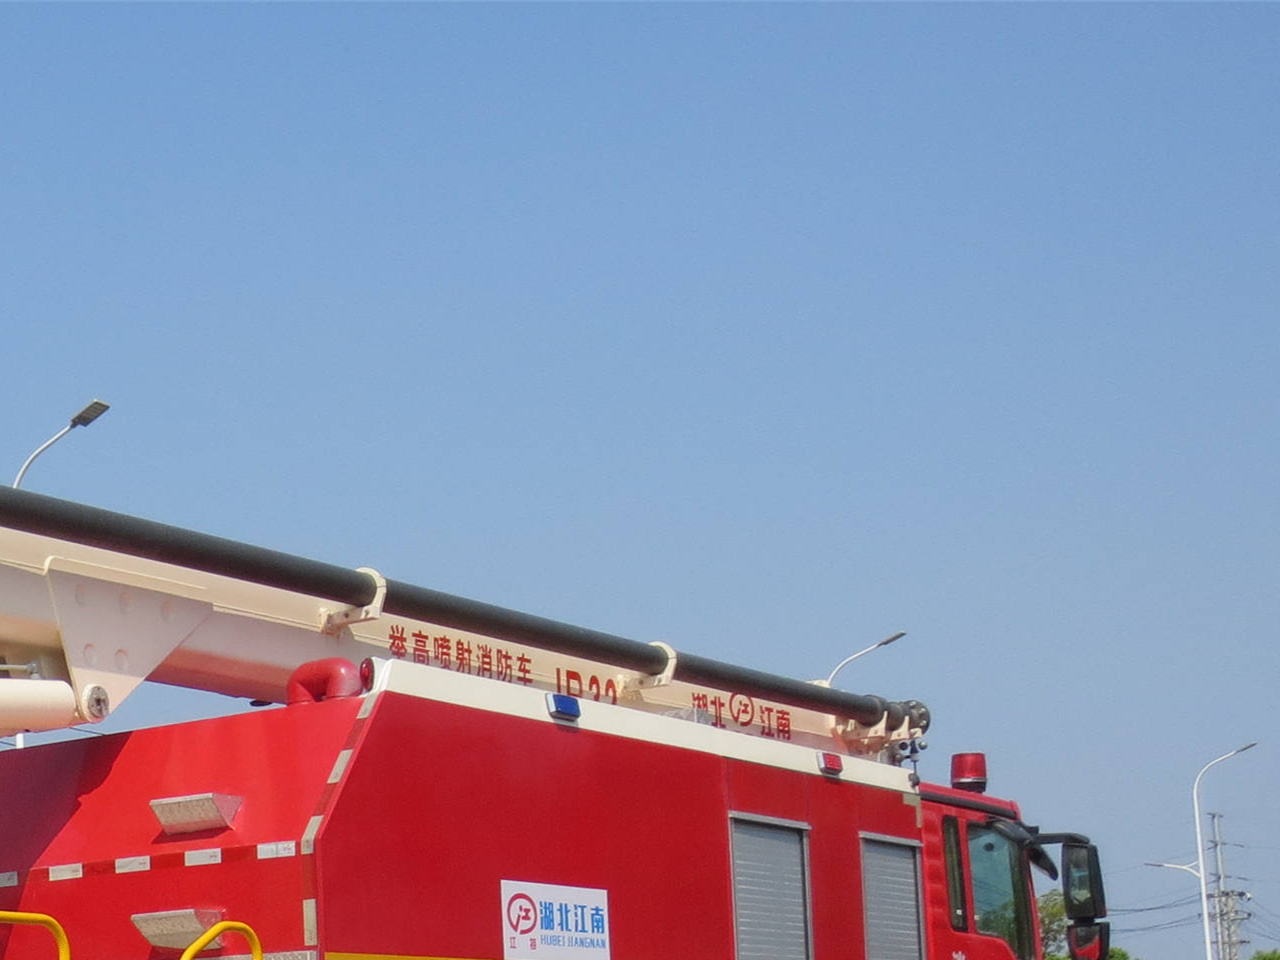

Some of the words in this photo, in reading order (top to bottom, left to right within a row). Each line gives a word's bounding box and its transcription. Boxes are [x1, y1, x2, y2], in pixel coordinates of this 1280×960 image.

[388, 624, 534, 687] 举高喷射消防车
[539, 900, 606, 934] 湖北江南
[540, 934, 566, 947] HUBEI
[567, 936, 607, 949] JIANGNAN
